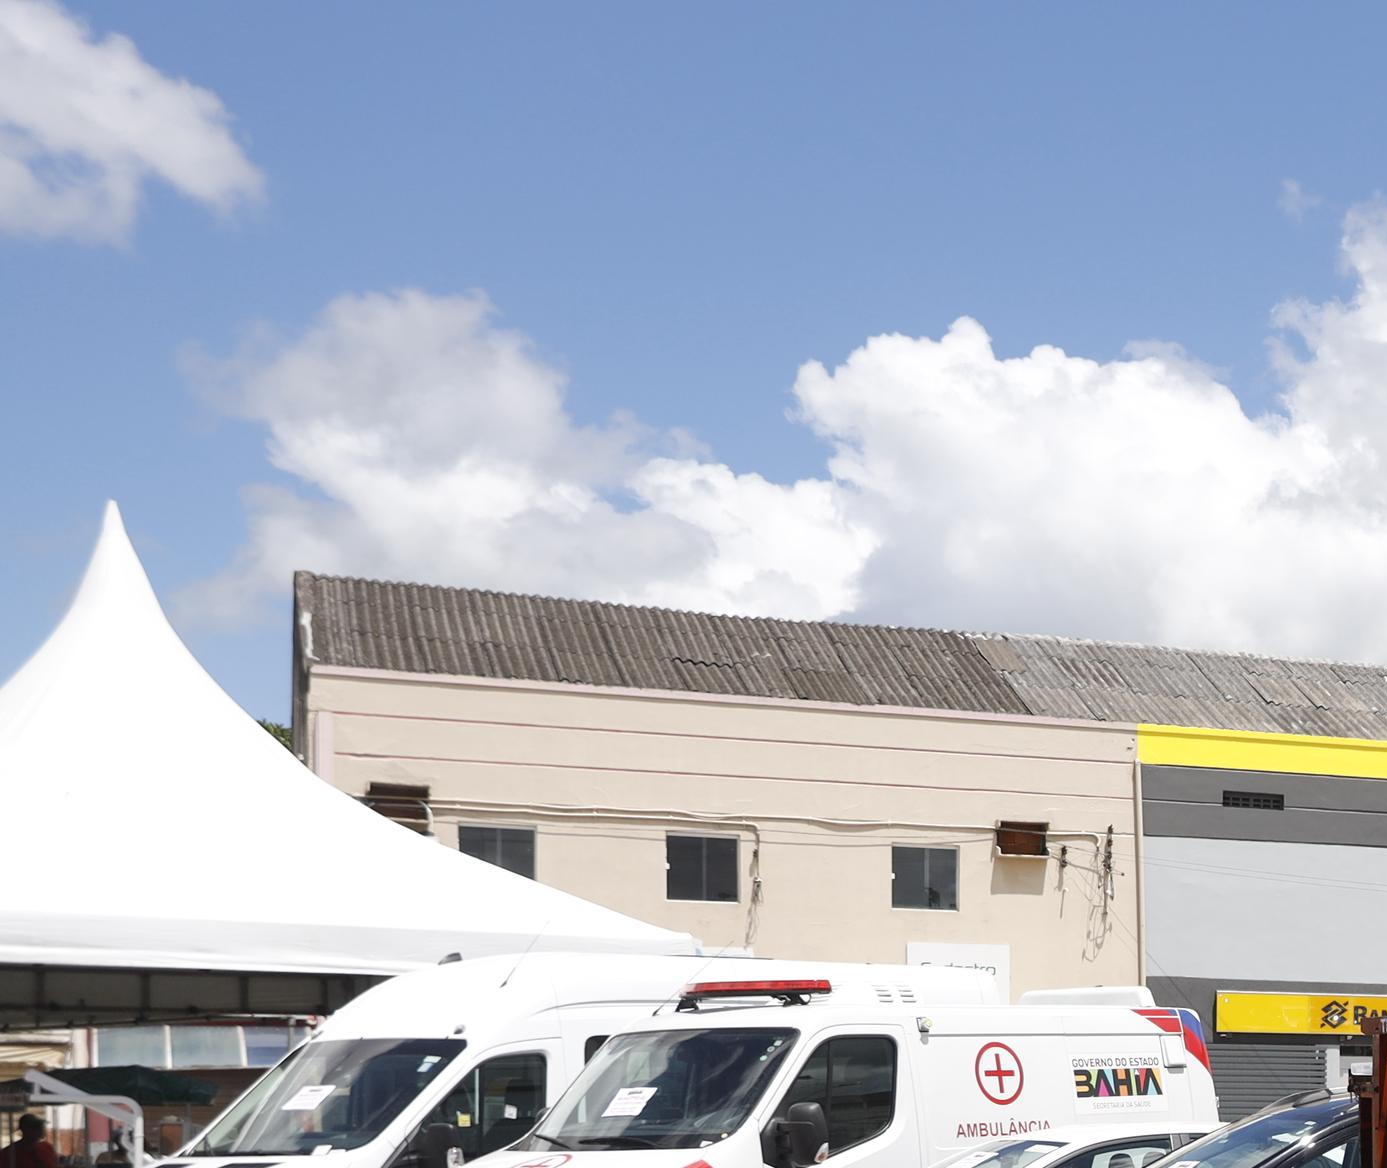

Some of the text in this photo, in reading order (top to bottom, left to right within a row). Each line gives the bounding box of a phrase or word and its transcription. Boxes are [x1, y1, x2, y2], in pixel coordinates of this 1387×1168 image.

[1072, 1056, 1159, 1068] GOVERNO DO ESTADO
[1073, 1068, 1163, 1098] BAHIA
[956, 1117, 1051, 1138] AMBULÂNCIA
